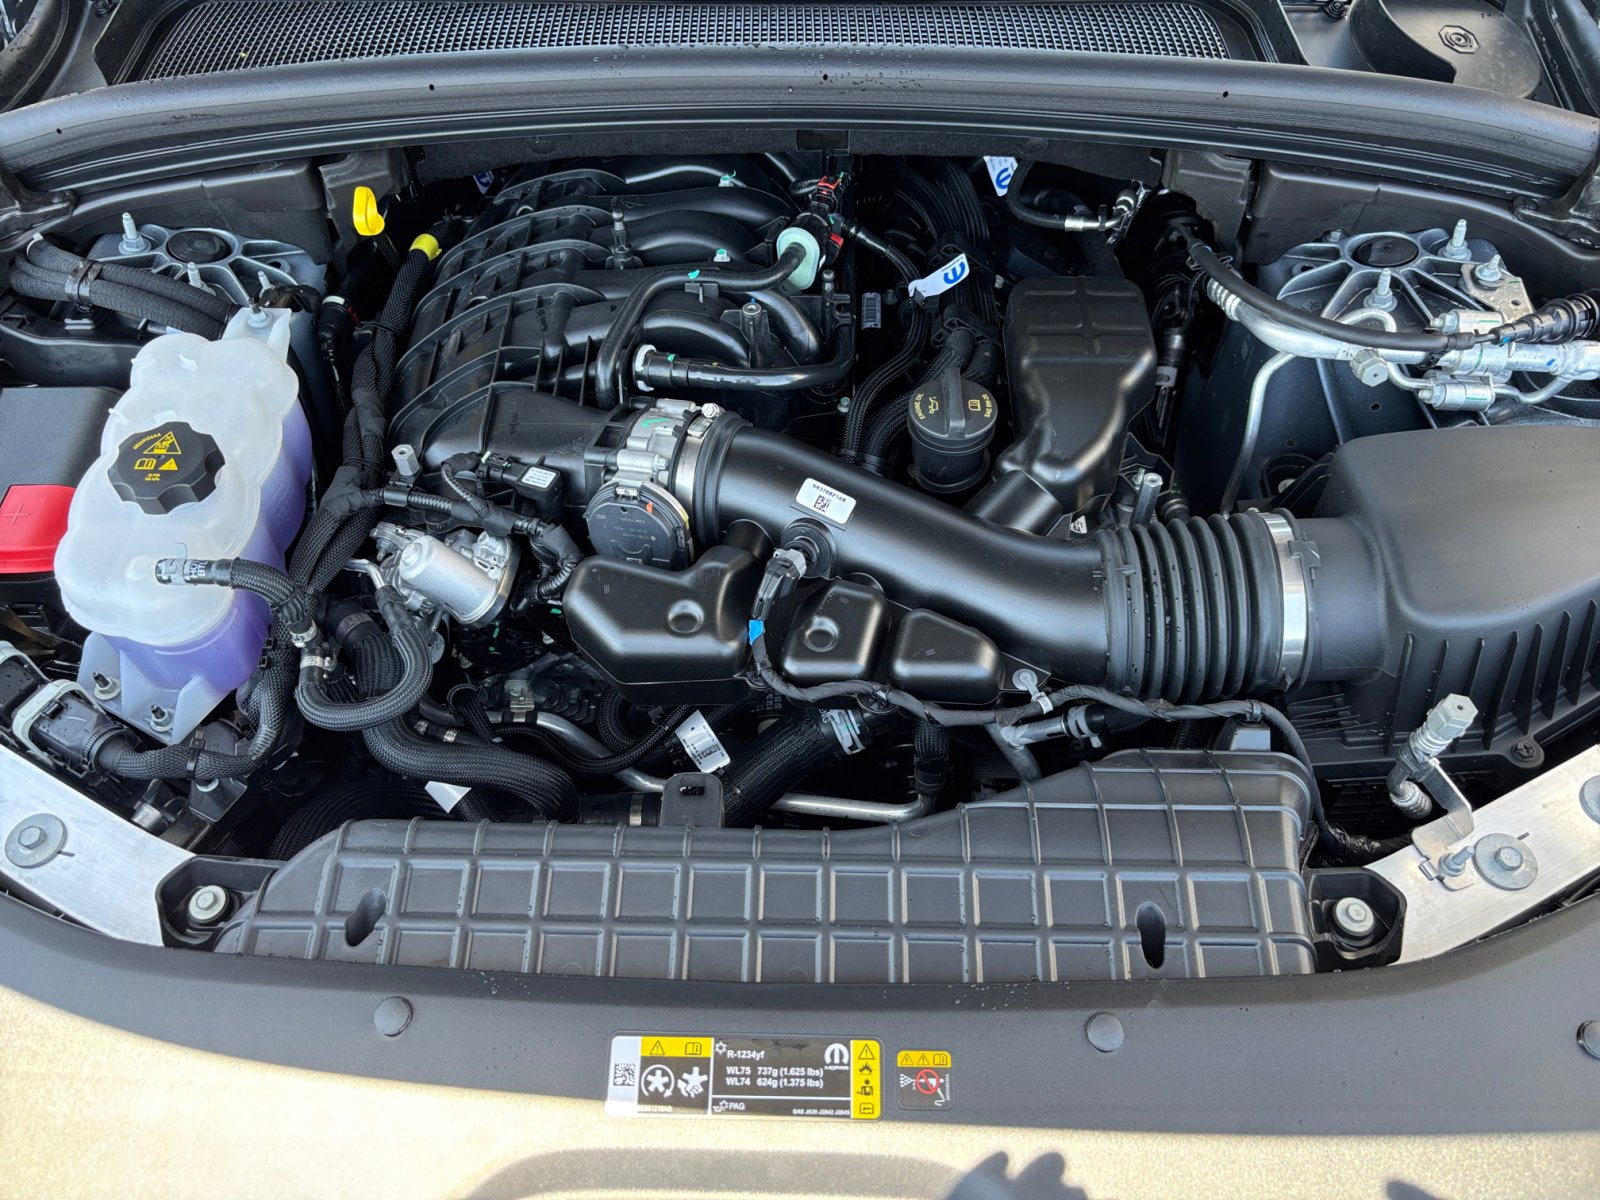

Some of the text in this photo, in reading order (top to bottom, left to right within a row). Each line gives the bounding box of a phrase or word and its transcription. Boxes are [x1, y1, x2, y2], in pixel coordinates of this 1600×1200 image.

[727, 1050, 765, 1060] R-1234yf
[726, 1066, 824, 1077] WL75 737g (1.625 lbs)
[726, 1077, 824, 1088] WL74 624g (1.375 lbs)
[729, 1102, 745, 1111] PAG
